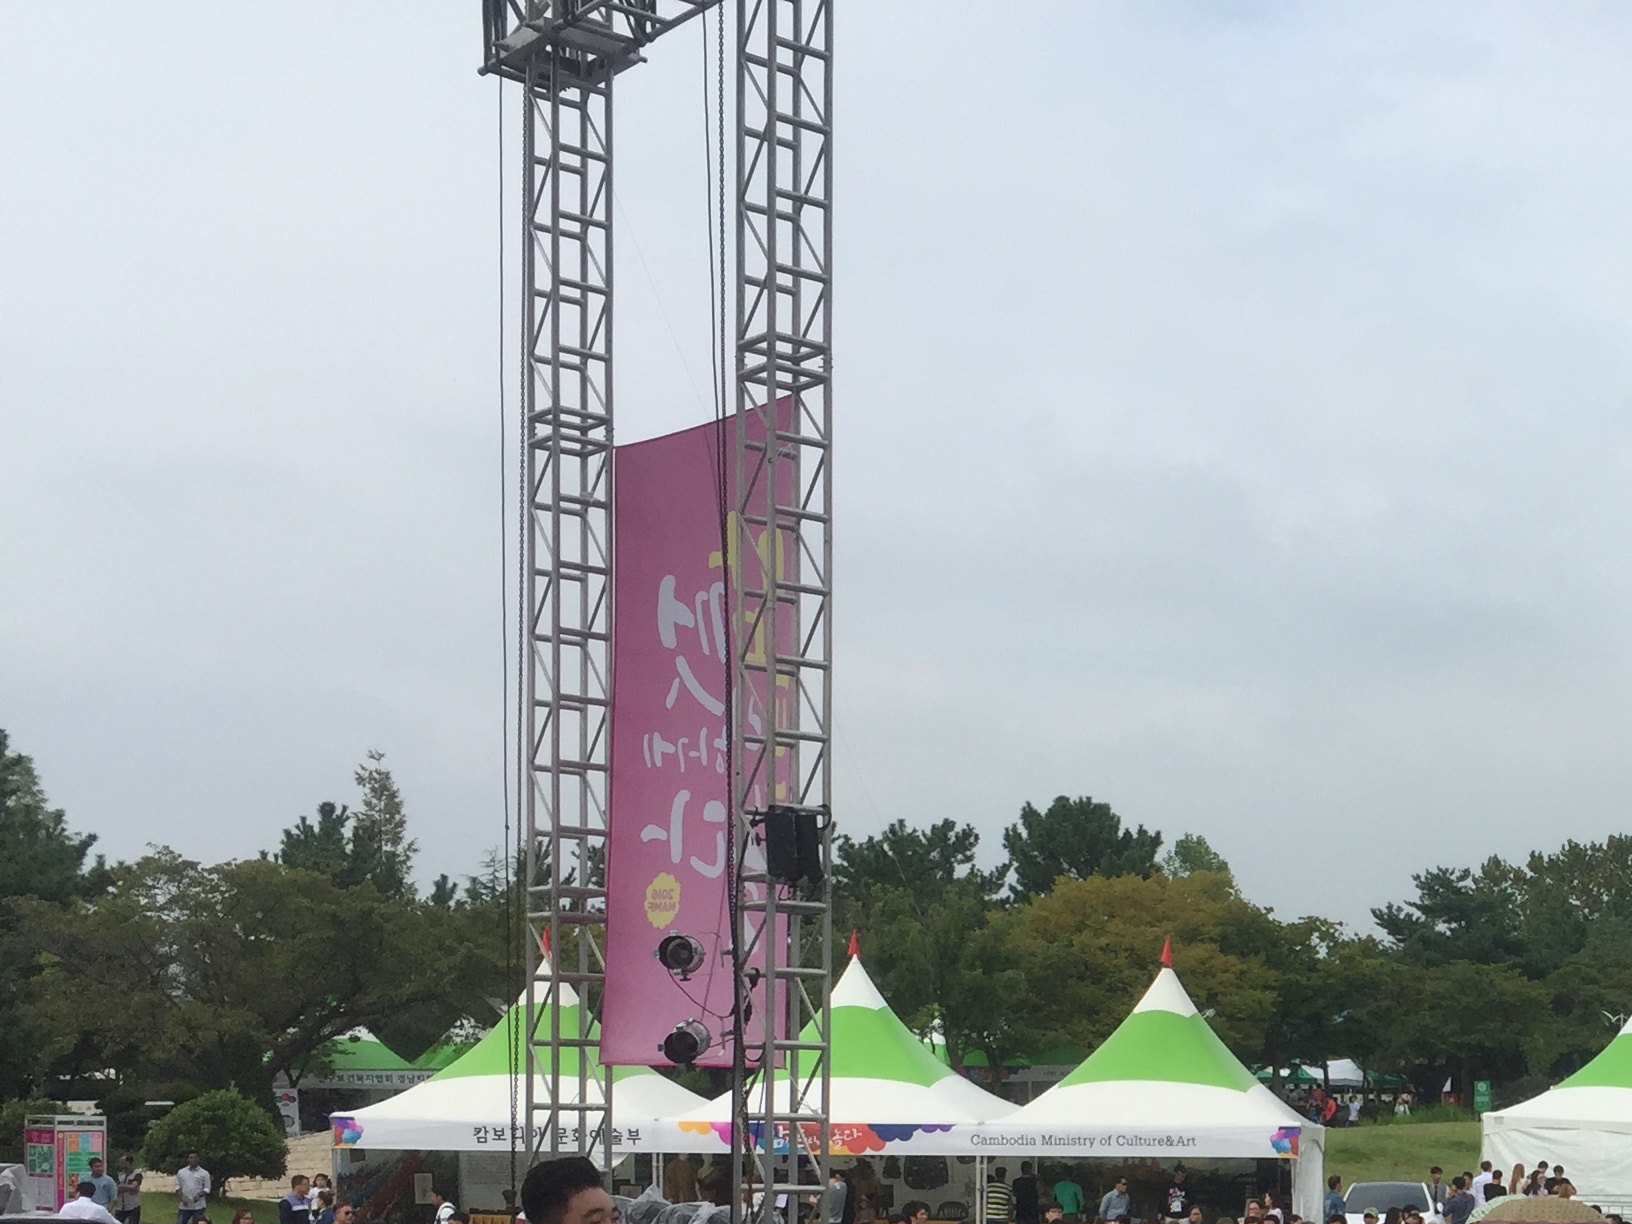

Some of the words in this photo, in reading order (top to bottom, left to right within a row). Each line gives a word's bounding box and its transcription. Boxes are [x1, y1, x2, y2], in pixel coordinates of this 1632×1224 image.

[970, 1134, 1037, 1147] Cambodia
[1041, 1134, 1096, 1149] Ministry
[1100, 1134, 1113, 1147] of
[1116, 1134, 1197, 1147] Culture&Art
